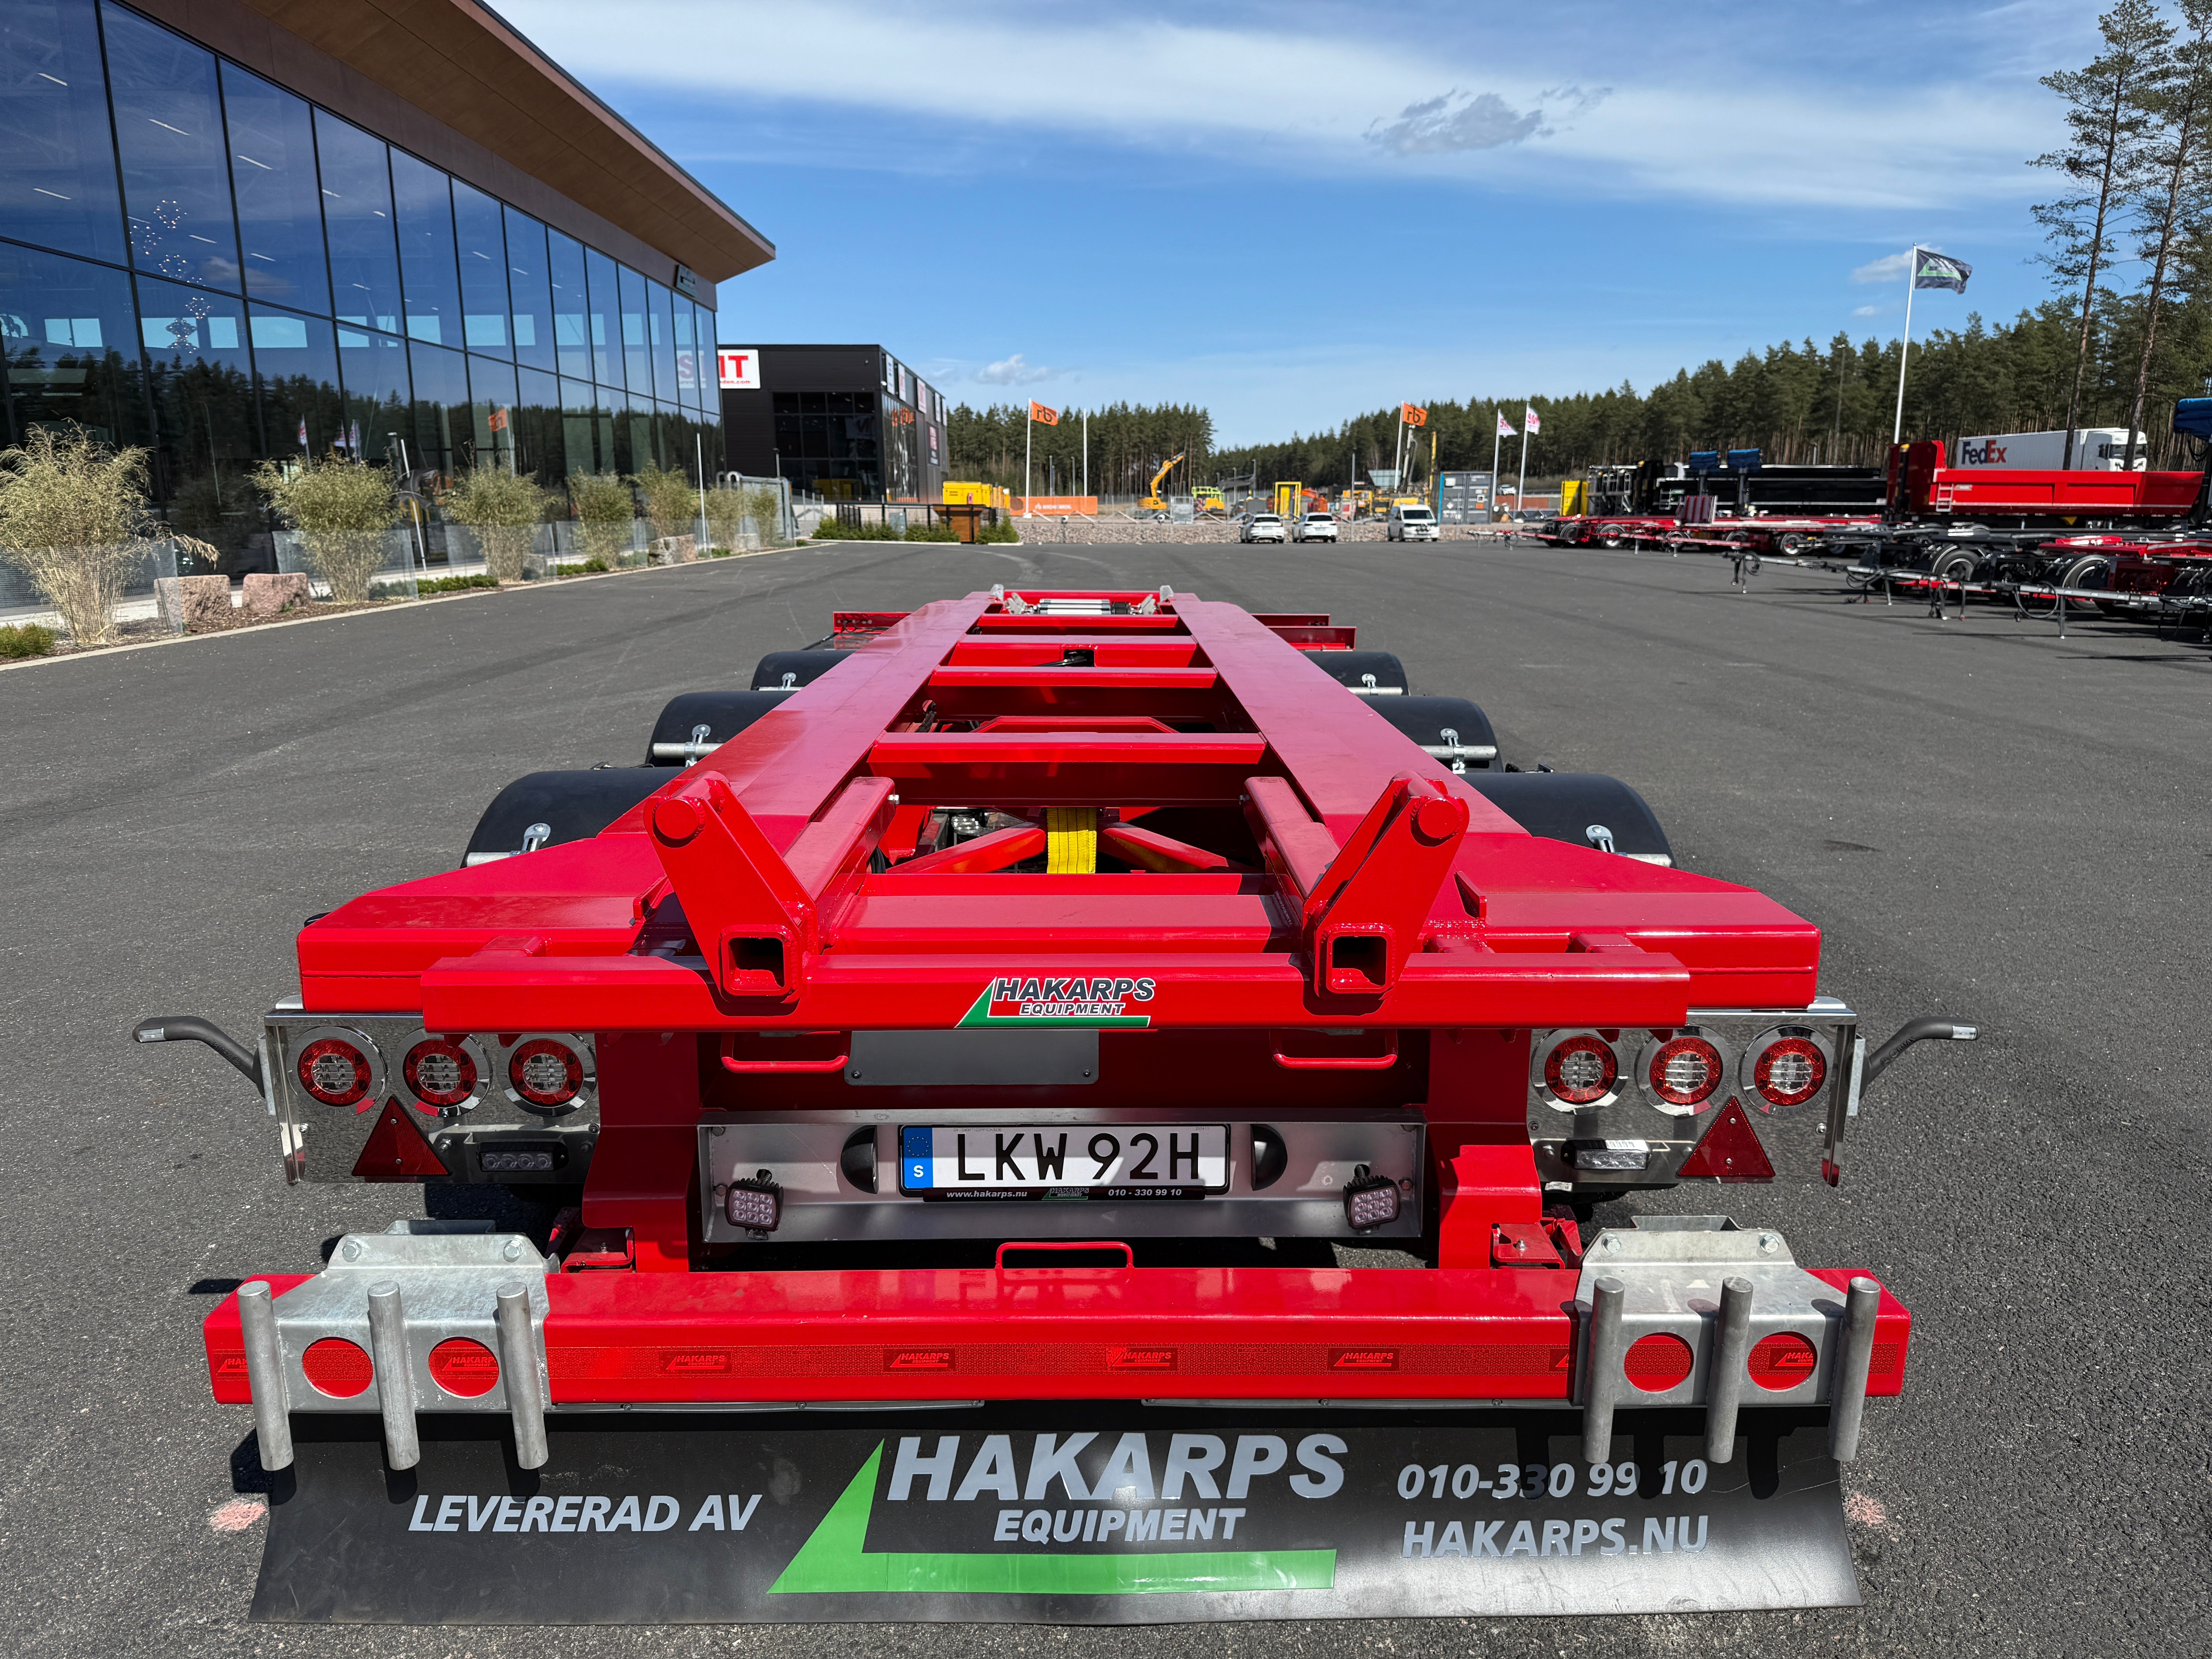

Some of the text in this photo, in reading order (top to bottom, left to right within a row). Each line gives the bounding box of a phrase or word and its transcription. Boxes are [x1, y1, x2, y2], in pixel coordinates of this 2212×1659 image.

[1961, 440, 2007, 465] FedEx
[994, 977, 1156, 1001] HAKARPS
[1019, 1003, 1126, 1016] EQUIPMENT
[914, 1165, 924, 1178] S
[958, 1133, 1199, 1180] LKW 92H
[946, 1190, 1027, 1199] www.hakarps.nu
[887, 1432, 1348, 1500] HAKARPS
[1397, 1459, 1708, 1499] 010-330 99 10
[409, 1494, 763, 1532] LEVERERAD AV
[994, 1508, 1246, 1544] EQUIPMENT
[1401, 1515, 1709, 1558] HAKARPS.NU
